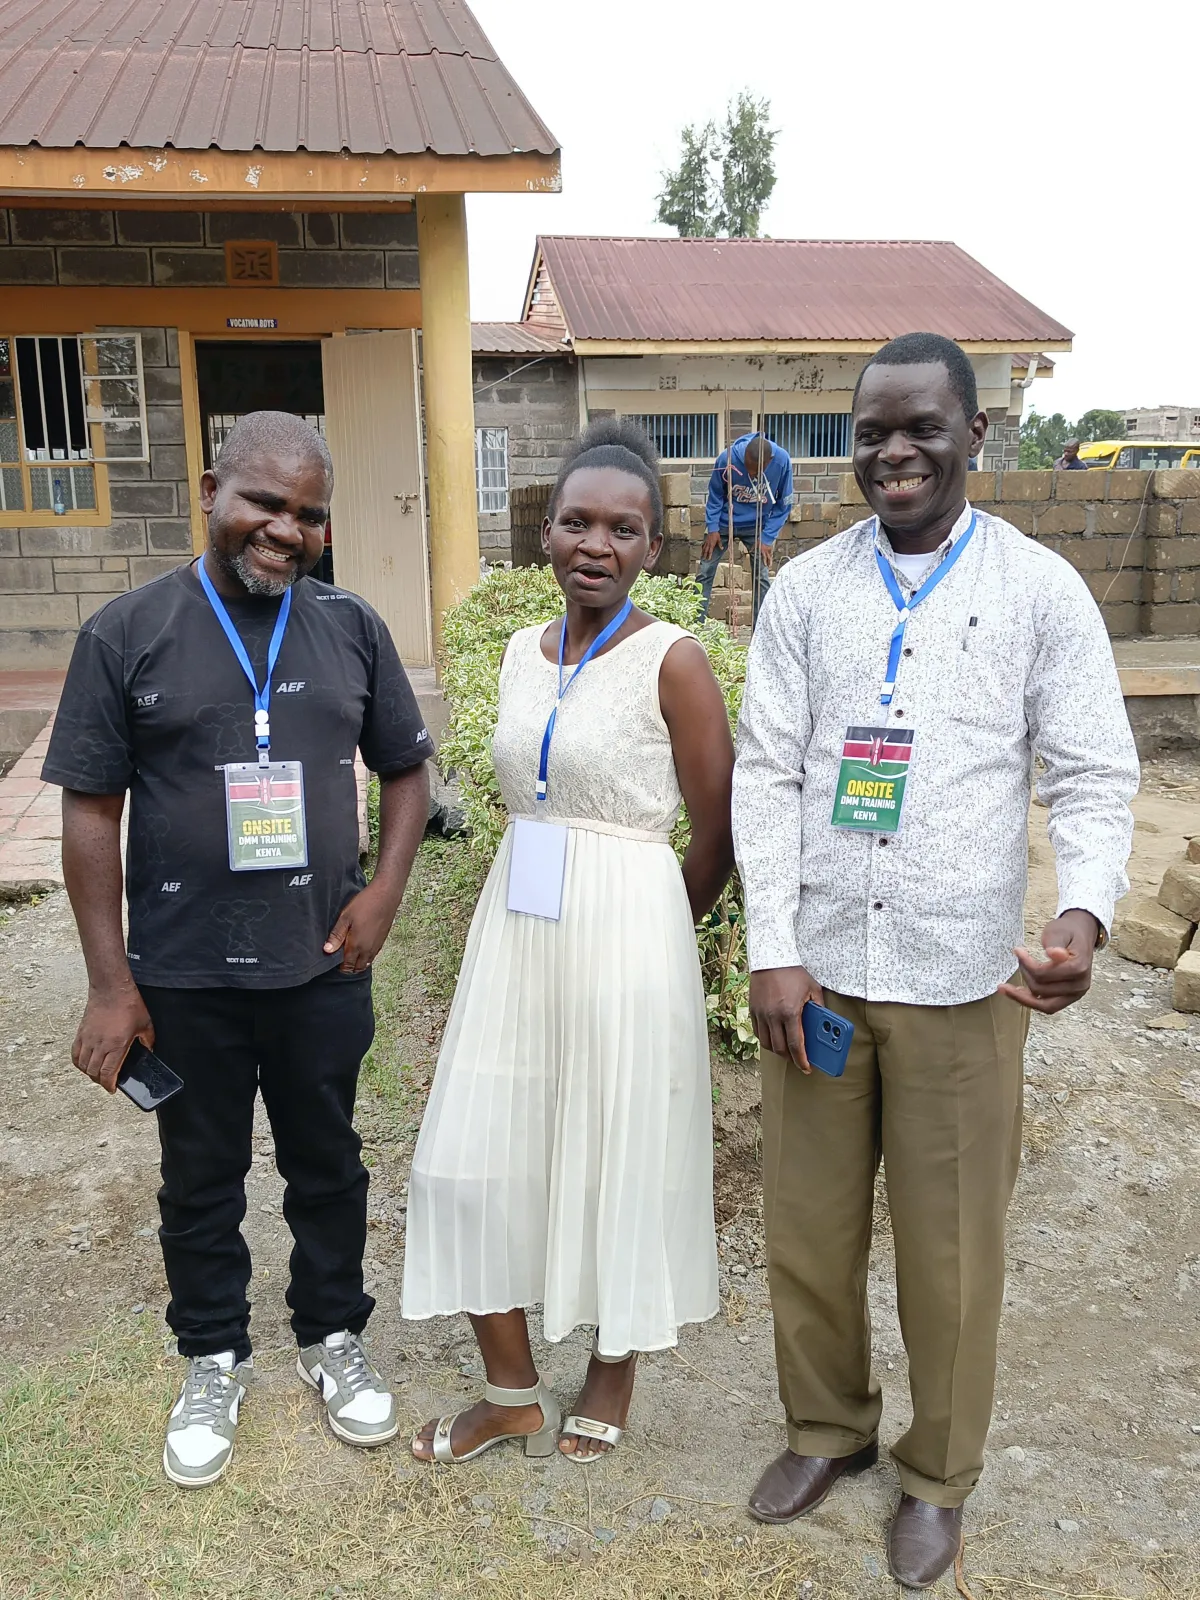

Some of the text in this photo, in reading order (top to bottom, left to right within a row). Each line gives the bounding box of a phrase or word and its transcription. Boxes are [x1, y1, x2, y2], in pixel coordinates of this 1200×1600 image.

[229, 318, 275, 328] VOCATION BOYS
[275, 681, 306, 693] AEF
[137, 693, 159, 707] AEF
[847, 779, 895, 799] ONSITE
[840, 795, 896, 809] DMM TRAINING
[852, 810, 877, 821] KENYA
[242, 818, 292, 835] ONSITE
[238, 833, 297, 845] DMM TRAINING
[255, 847, 282, 857] KENYA
[288, 874, 313, 886] AEF
[161, 882, 181, 892] AEF
